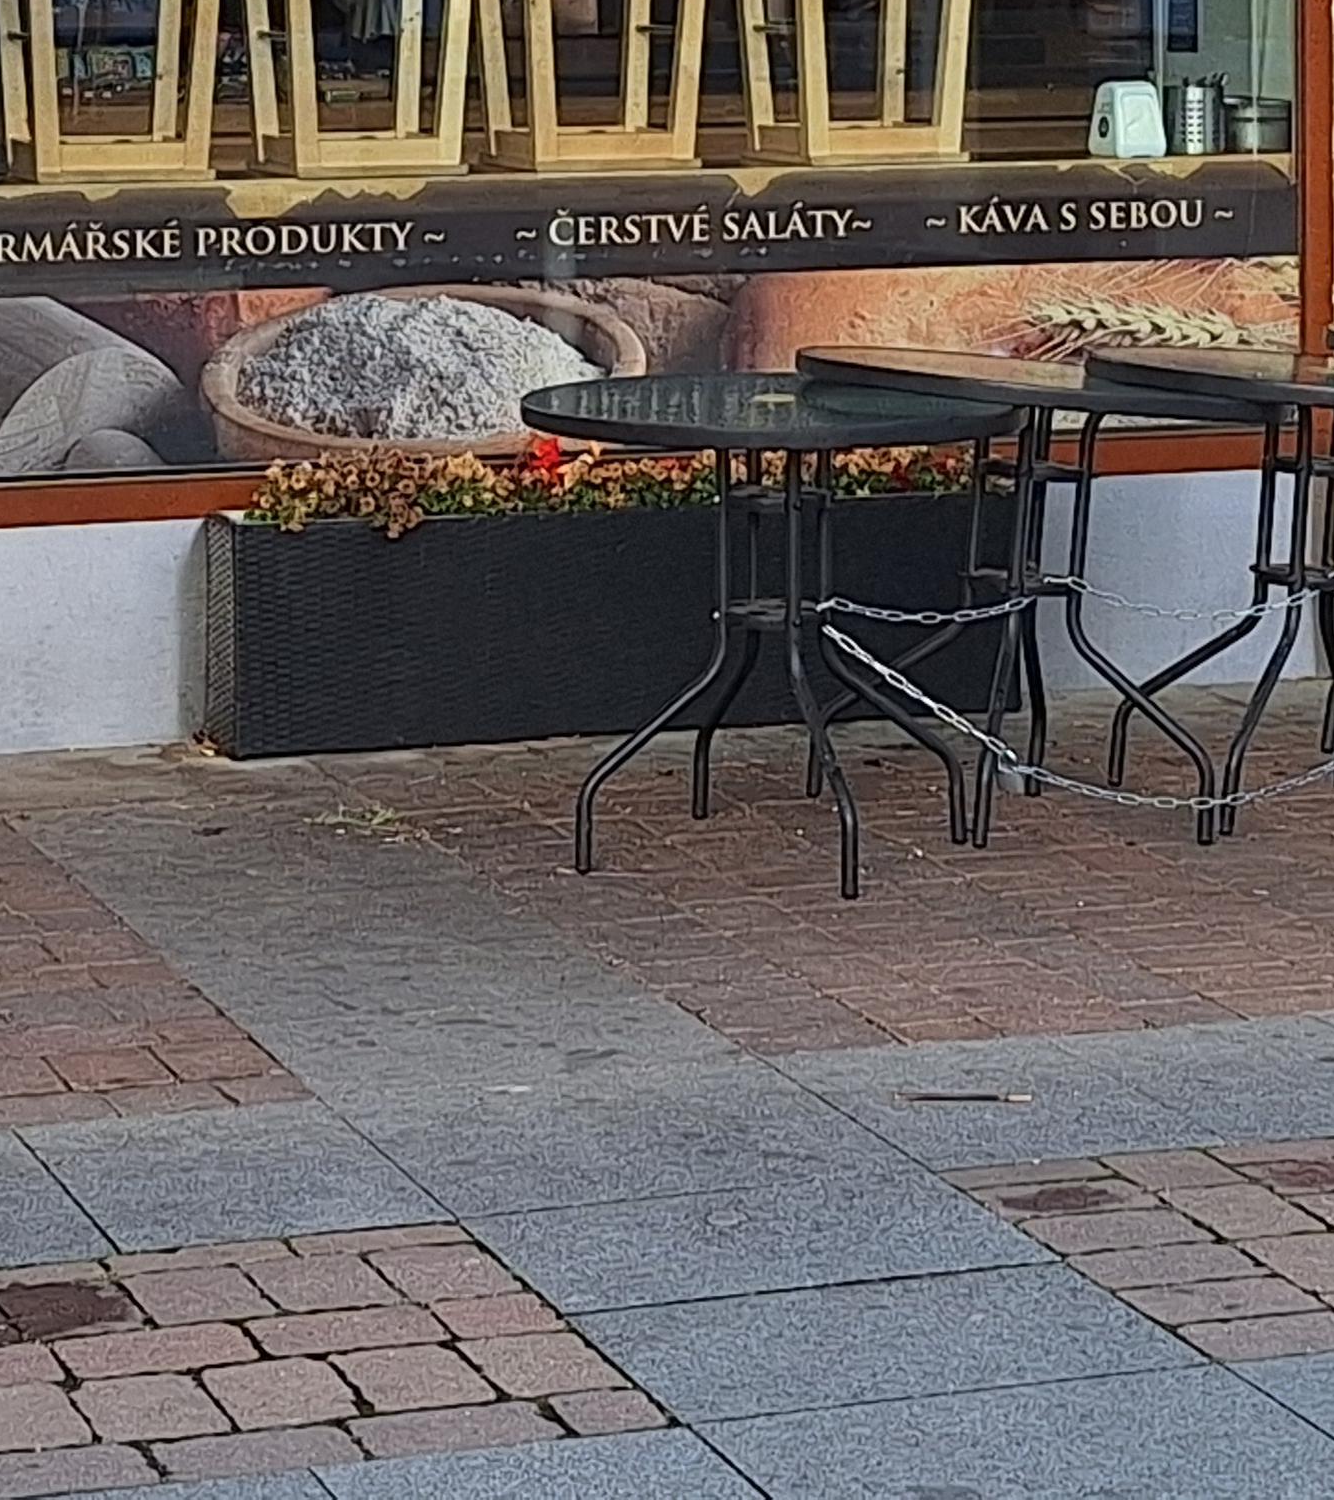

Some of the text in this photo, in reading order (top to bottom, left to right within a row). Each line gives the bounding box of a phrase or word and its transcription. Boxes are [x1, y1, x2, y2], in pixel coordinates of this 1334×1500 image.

[548, 204, 712, 246] ČERSTVÉ
[958, 197, 1206, 234] KÁVA S SEBOU
[196, 221, 416, 258] PRODUKTY
